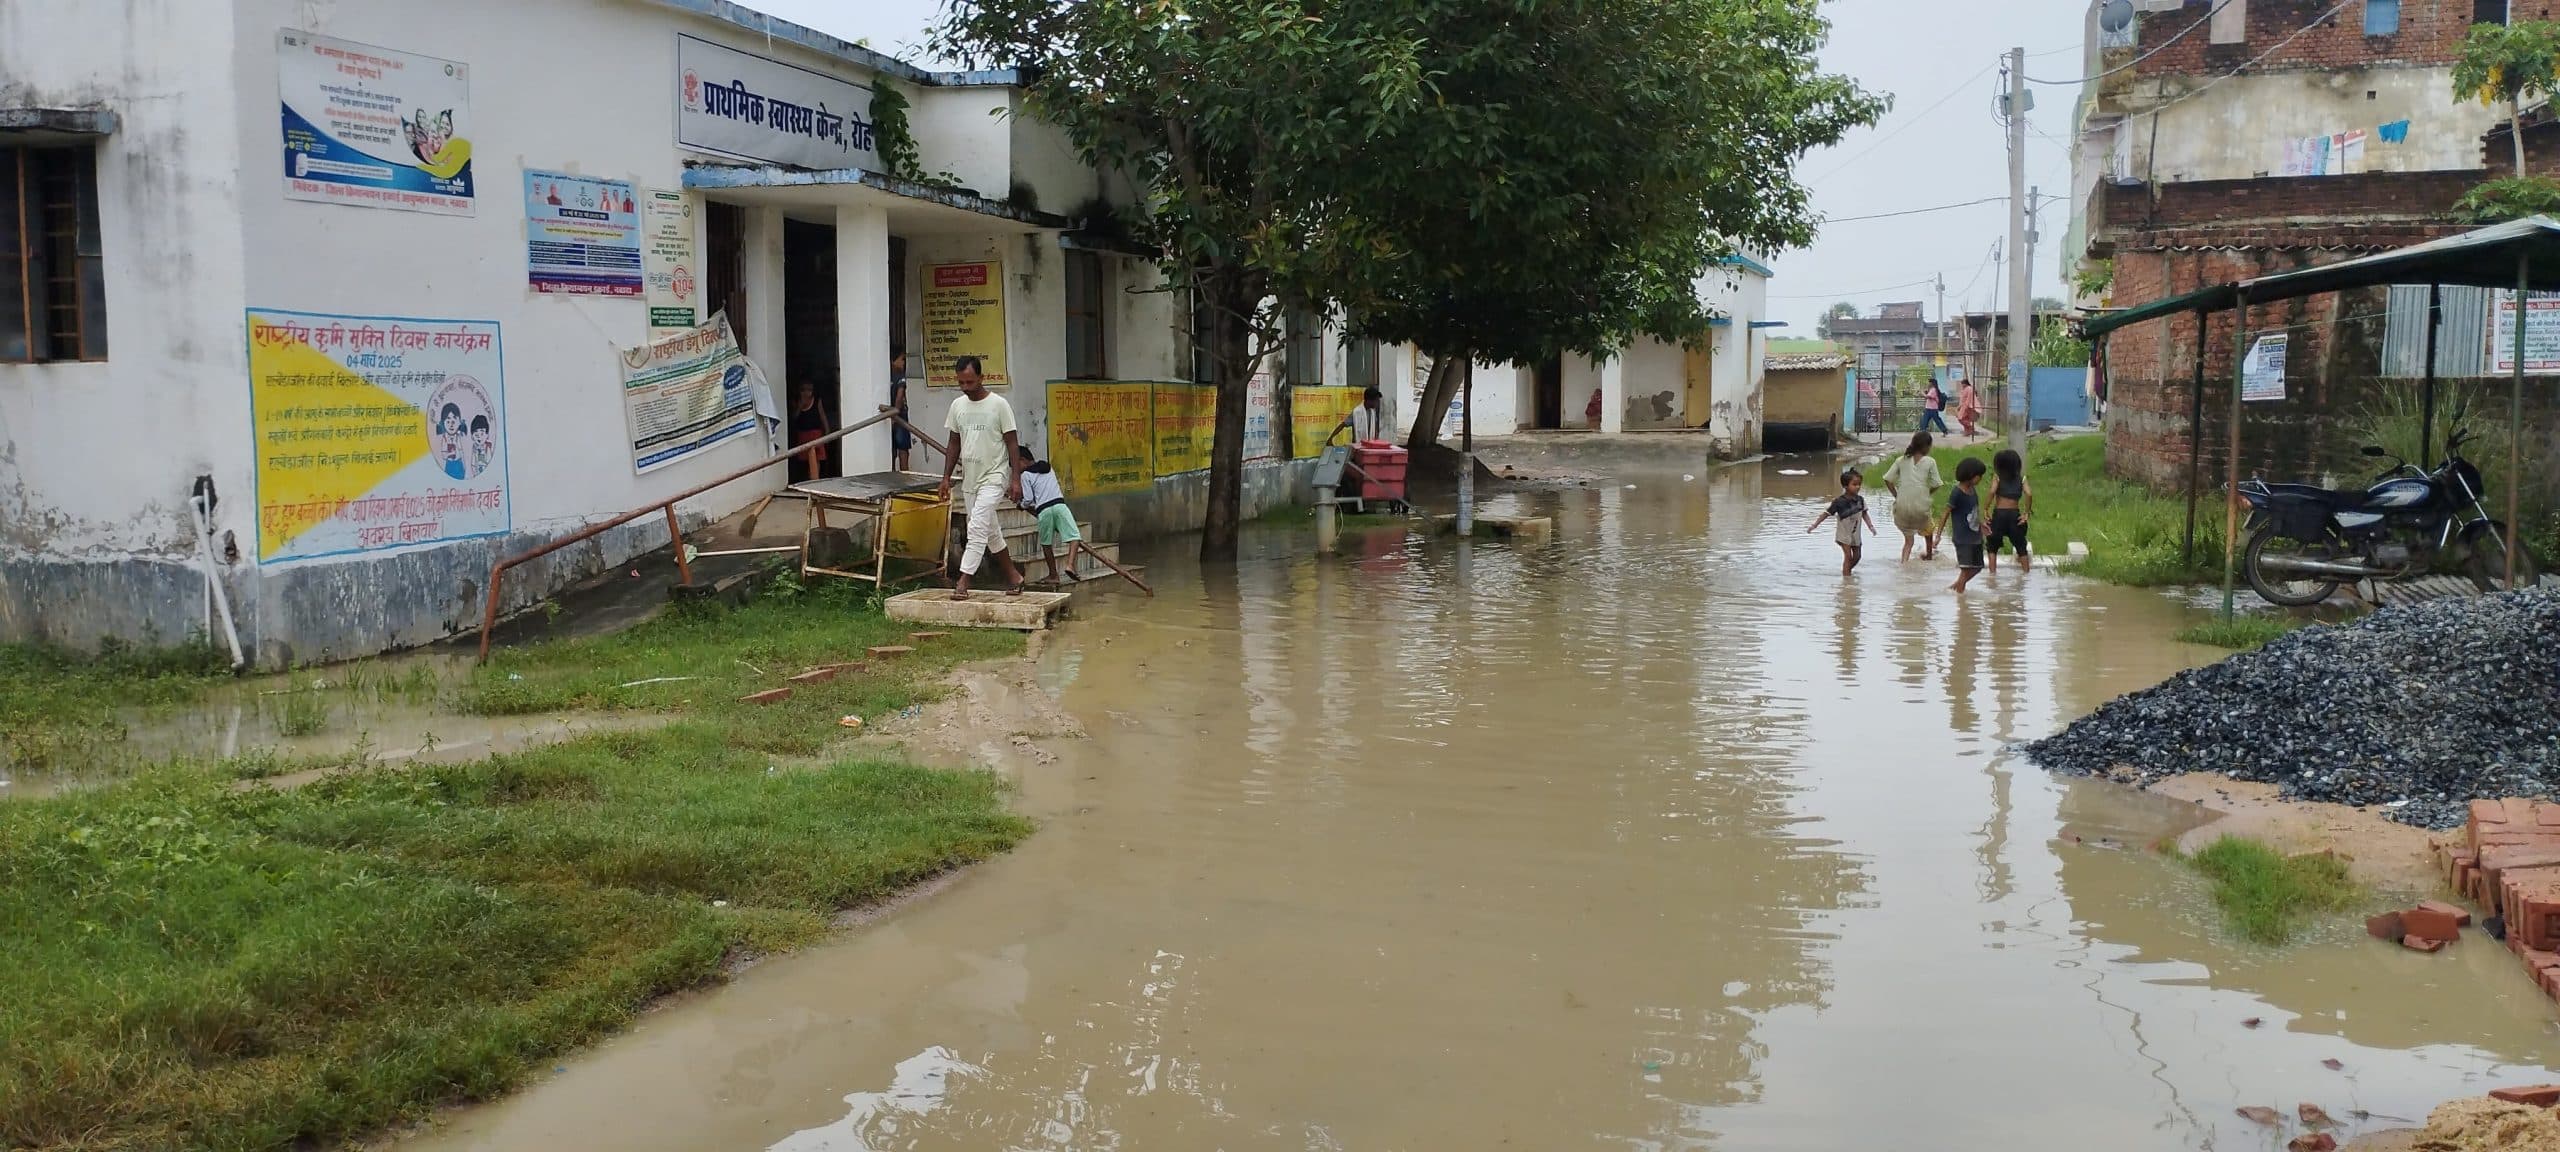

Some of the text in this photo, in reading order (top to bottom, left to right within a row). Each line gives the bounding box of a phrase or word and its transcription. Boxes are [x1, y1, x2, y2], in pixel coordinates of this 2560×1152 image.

[703, 79, 765, 125] प्राथमिक
[768, 97, 813, 138] स्वास्थ्य
[815, 102, 848, 154] केन्द्र,
[256, 320, 492, 356] राष्ट्रीय कृमि मुक्ति दिवस कार्यक्रम
[653, 337, 684, 360] राष्ट्रीय
[346, 355, 361, 368] 04
[378, 355, 403, 368] 2025
[357, 525, 394, 549] अवश्य
